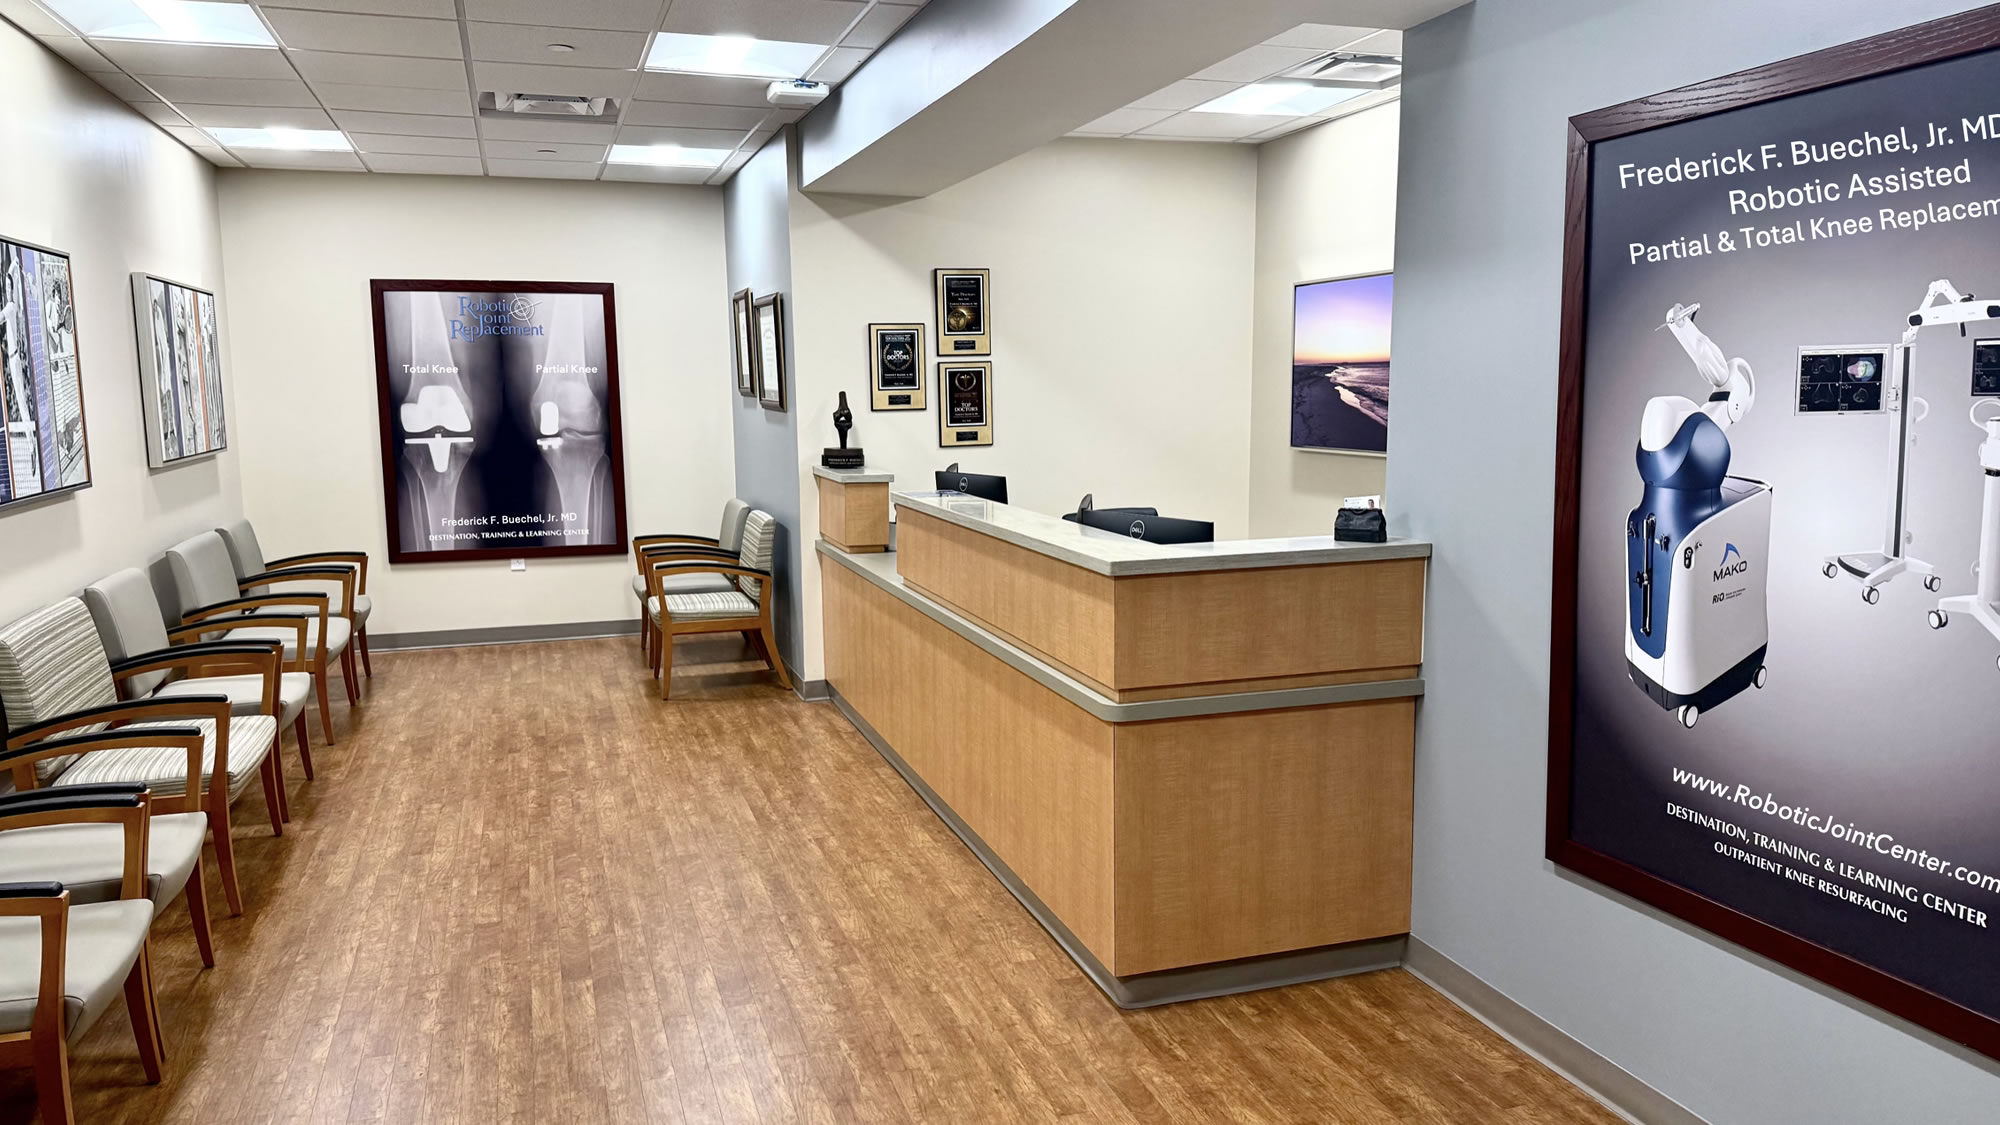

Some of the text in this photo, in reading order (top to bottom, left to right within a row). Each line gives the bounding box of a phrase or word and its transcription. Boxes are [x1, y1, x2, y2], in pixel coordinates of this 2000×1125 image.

[1619, 148, 1755, 189] Frederick
[1761, 144, 1783, 169] F.
[1792, 127, 1918, 167] Buechel,
[1926, 123, 1953, 149] Jr.
[1729, 158, 1971, 215] Robotic Assisted
[1629, 233, 1712, 265] Partial
[1717, 230, 1736, 253] &
[1740, 220, 1804, 250] Total
[1810, 214, 1872, 240] Knee
[478, 313, 512, 337] Joint
[403, 365, 458, 373] Total Knee
[536, 365, 598, 373] Partial Knee
[429, 533, 480, 541] DESTINATION,
[442, 513, 577, 526] Frederick F. Buechel, Jr. MD
[1713, 561, 1747, 582] MAKO
[1672, 767, 2000, 893] www.RoboticJointCenter.com
[1666, 802, 1988, 928] DESTINATION, TRAINING & LEARNING CENTER
[1714, 841, 1908, 923] OUTPATIENT KNEE RESURFACING
